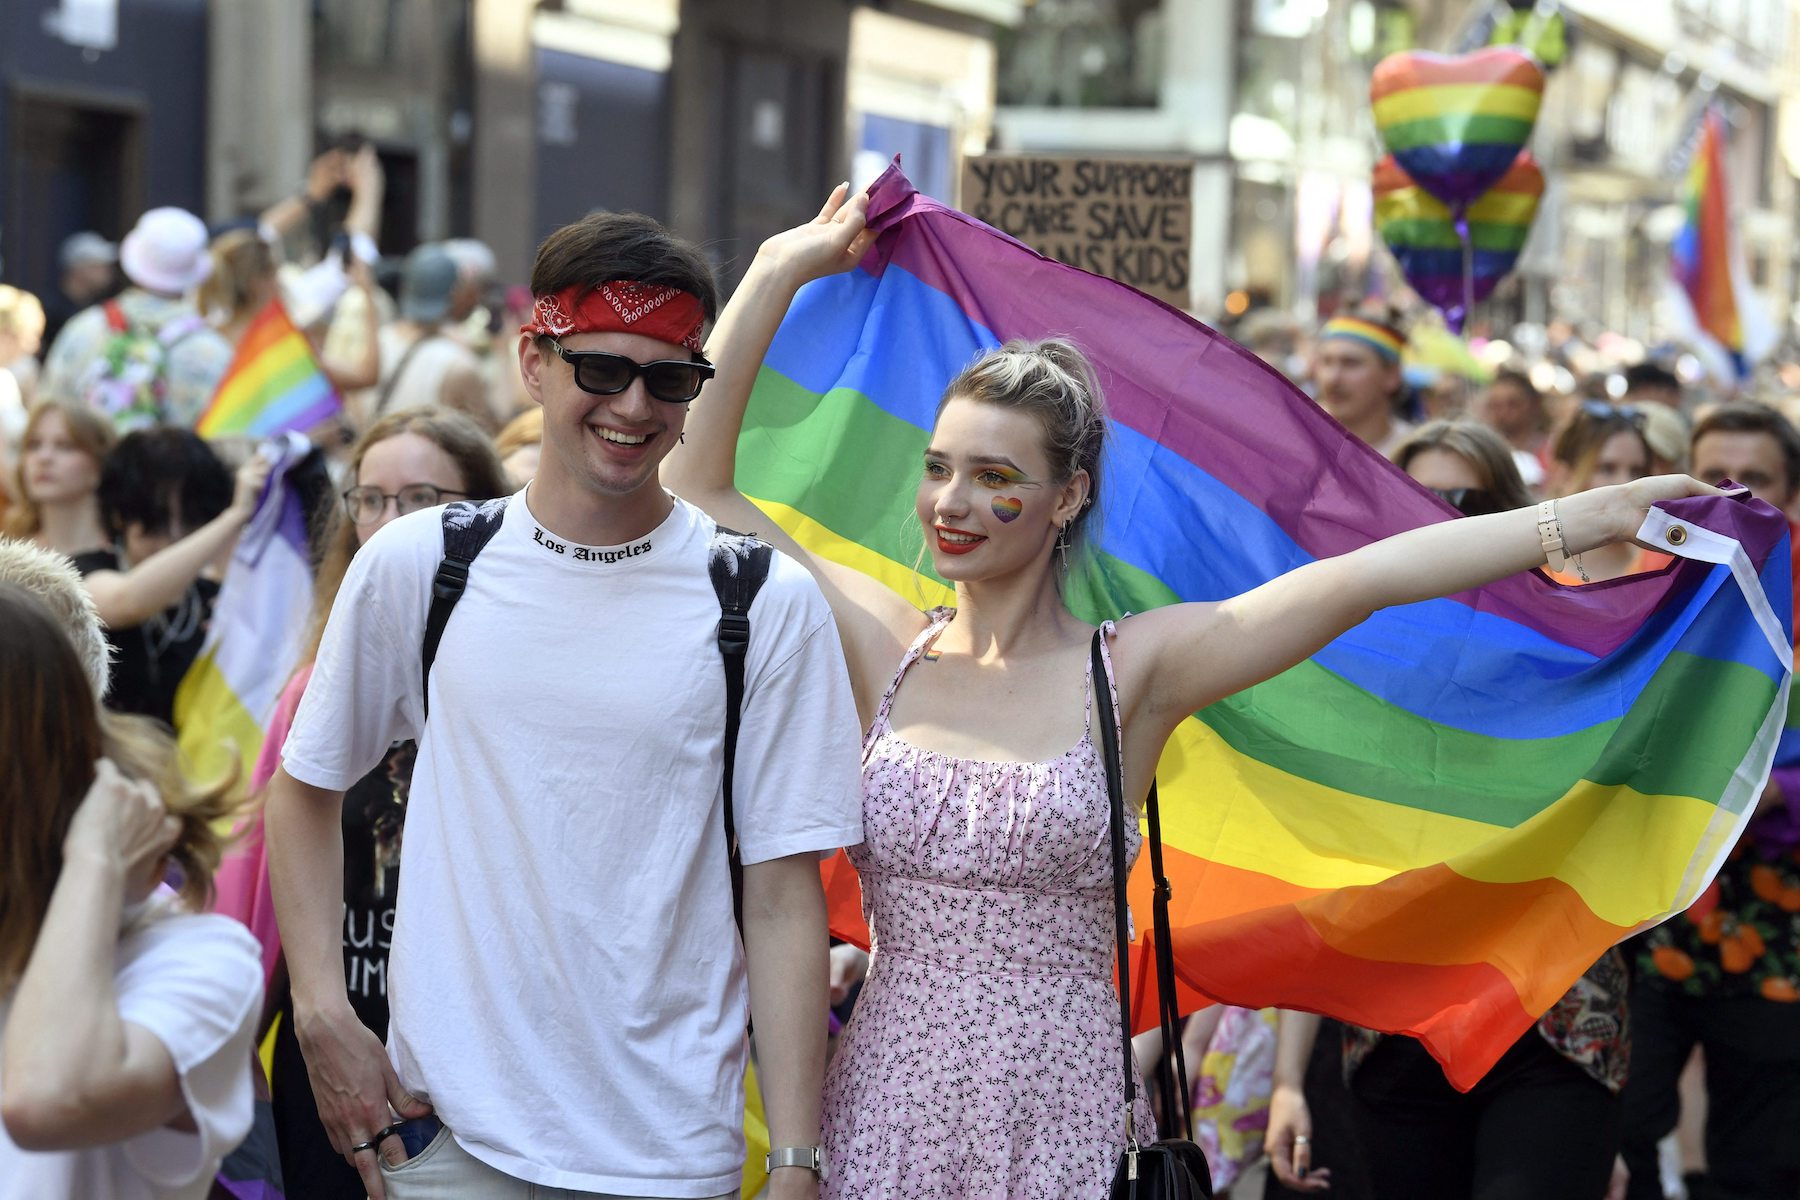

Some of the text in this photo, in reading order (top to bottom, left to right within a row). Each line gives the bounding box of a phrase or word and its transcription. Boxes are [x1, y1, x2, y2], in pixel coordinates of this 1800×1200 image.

[971, 160, 1192, 198] YOUR SUPPORT
[1086, 203, 1184, 242] SAVE
[1113, 244, 1190, 291] KIDS
[532, 526, 652, 563] Los Angeles
